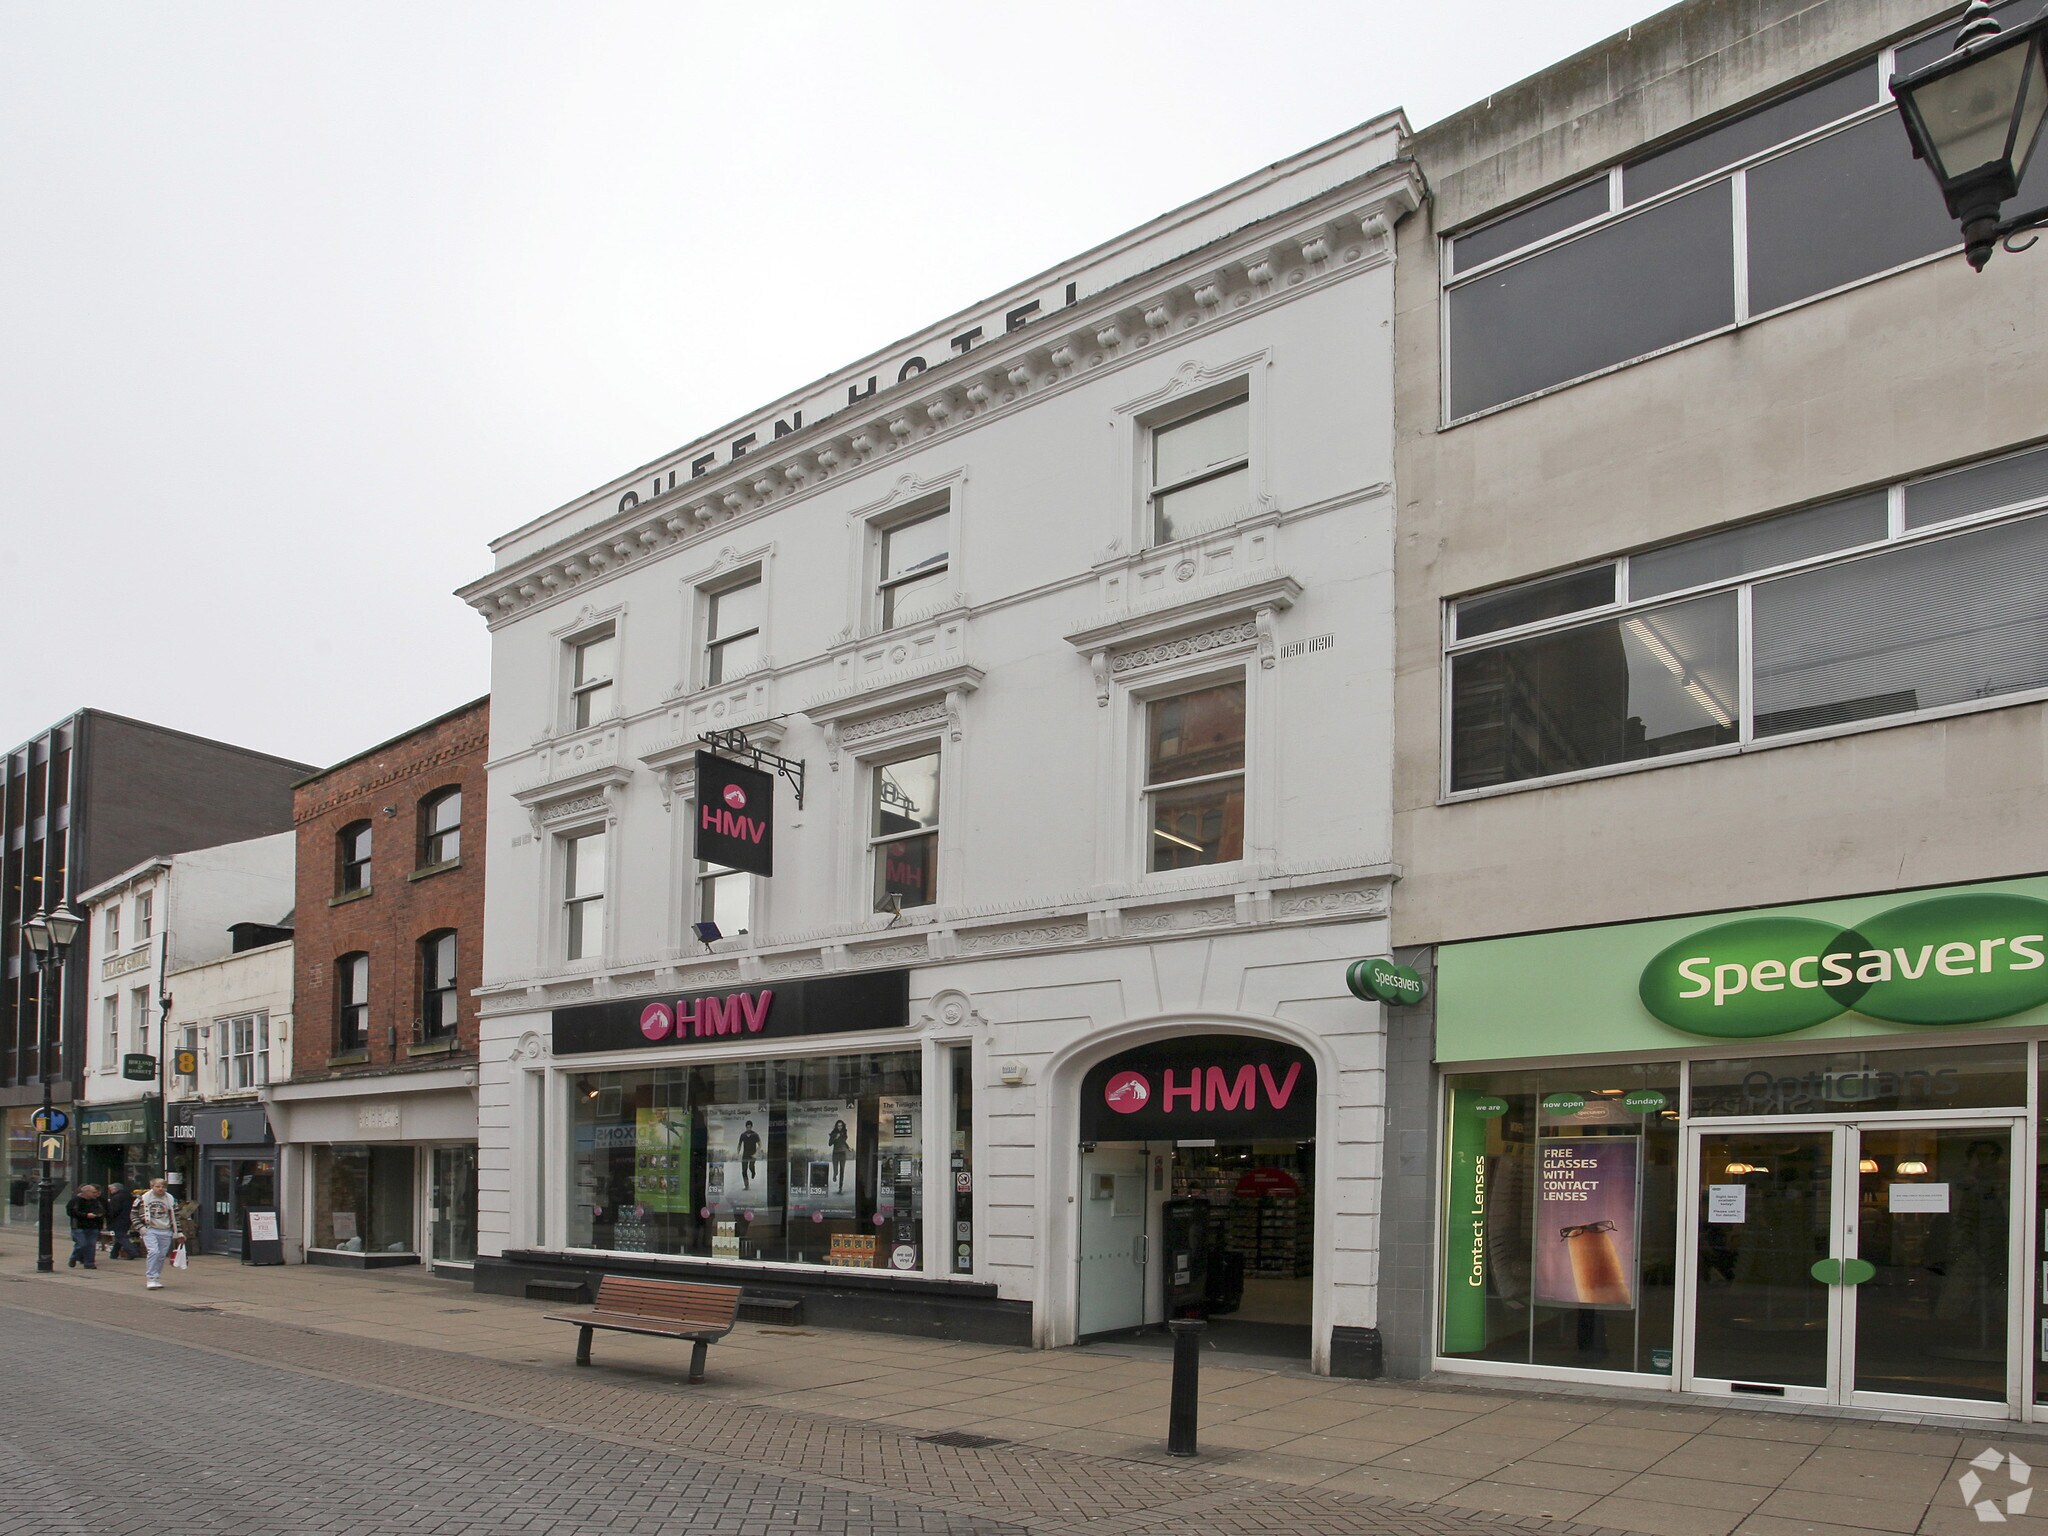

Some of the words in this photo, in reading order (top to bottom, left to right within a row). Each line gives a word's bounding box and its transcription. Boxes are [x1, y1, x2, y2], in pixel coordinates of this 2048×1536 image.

[702, 804, 766, 844] HMV
[1374, 967, 1420, 993] Specsavers
[1678, 934, 2046, 1007] Specsavers
[677, 989, 772, 1038] HMV
[1163, 1061, 1302, 1113] HMV
[1742, 1064, 1959, 1108] Opticians
[1562, 1100, 1584, 1109] open
[1626, 1098, 1663, 1107] Sundays
[1543, 1159, 1597, 1169] GLASSES
[1544, 1149, 1573, 1158] FREE
[1472, 1155, 1485, 1215] Lenses
[1543, 1170, 1574, 1179] WITH
[1543, 1181, 1599, 1190] CONTACT
[1543, 1192, 1588, 1201] LENSES
[1469, 1220, 1484, 1287] Contact
